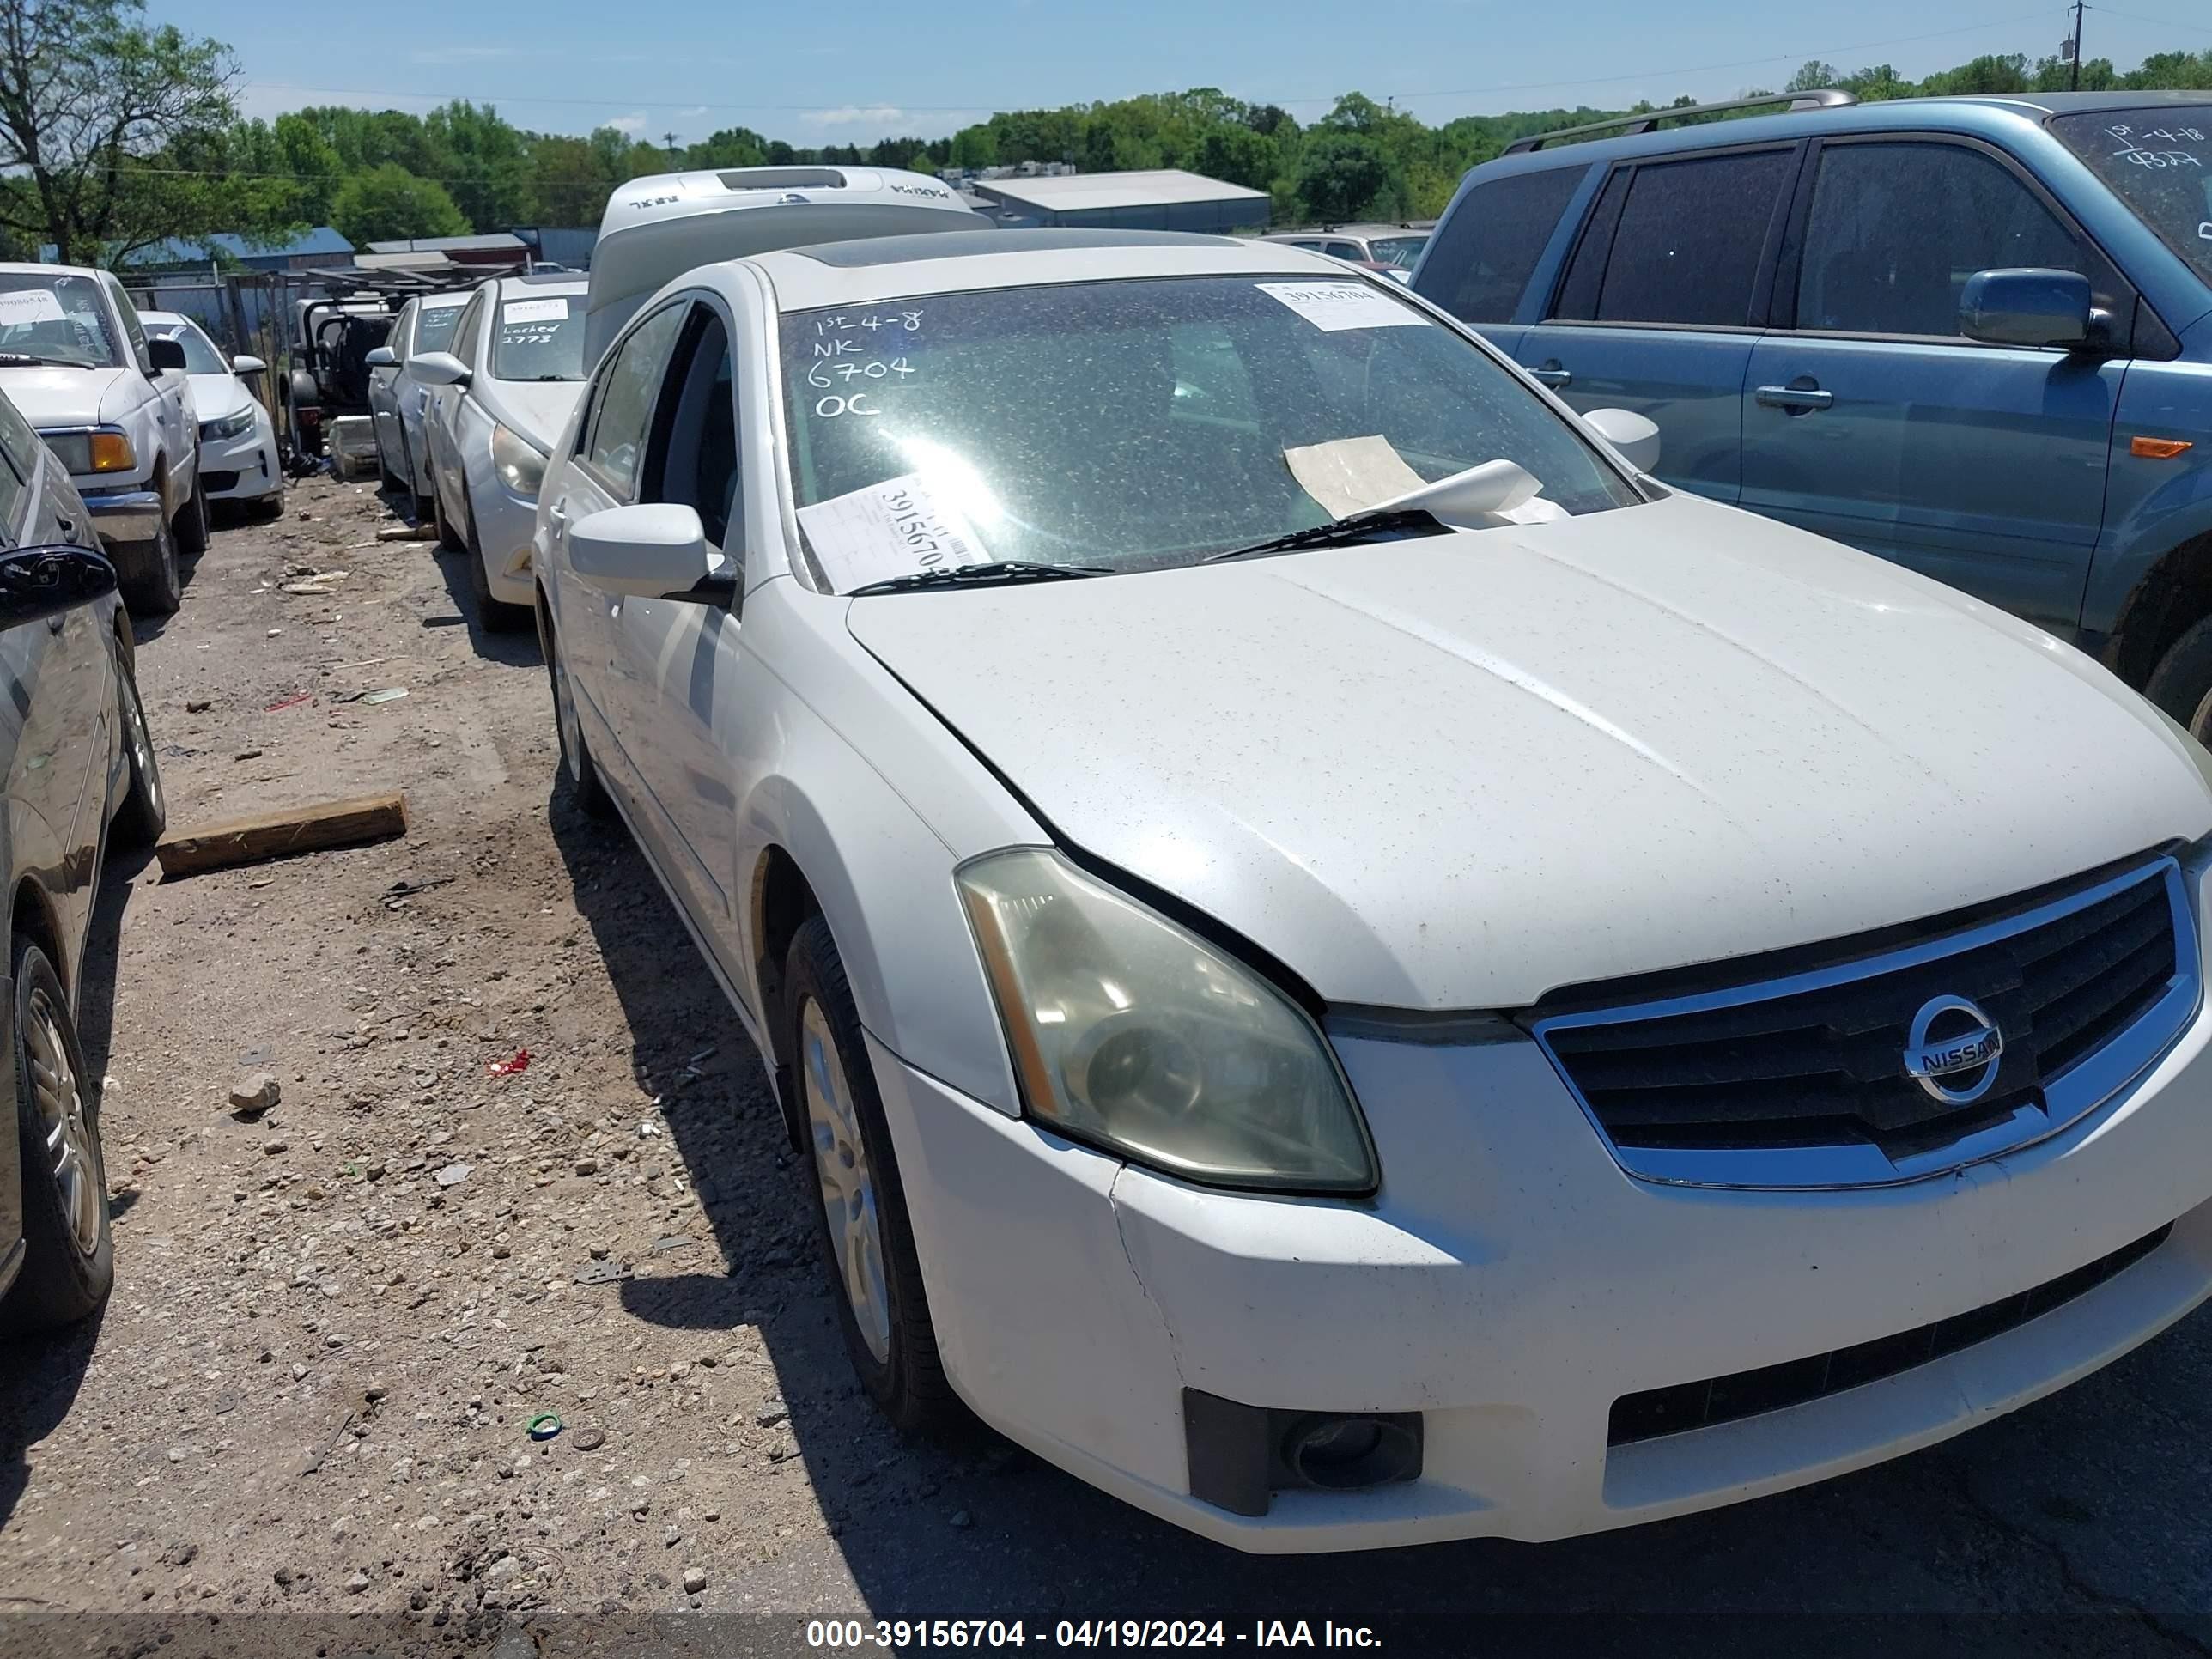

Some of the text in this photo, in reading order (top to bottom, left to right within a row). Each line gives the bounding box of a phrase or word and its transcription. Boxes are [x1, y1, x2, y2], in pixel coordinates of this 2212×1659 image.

[1285, 290, 1375, 301] 39156704
[813, 338, 865, 357] NK
[807, 357, 917, 388] 6704
[815, 392, 882, 418] OC
[1921, 1037, 2001, 1072] NISSAN
